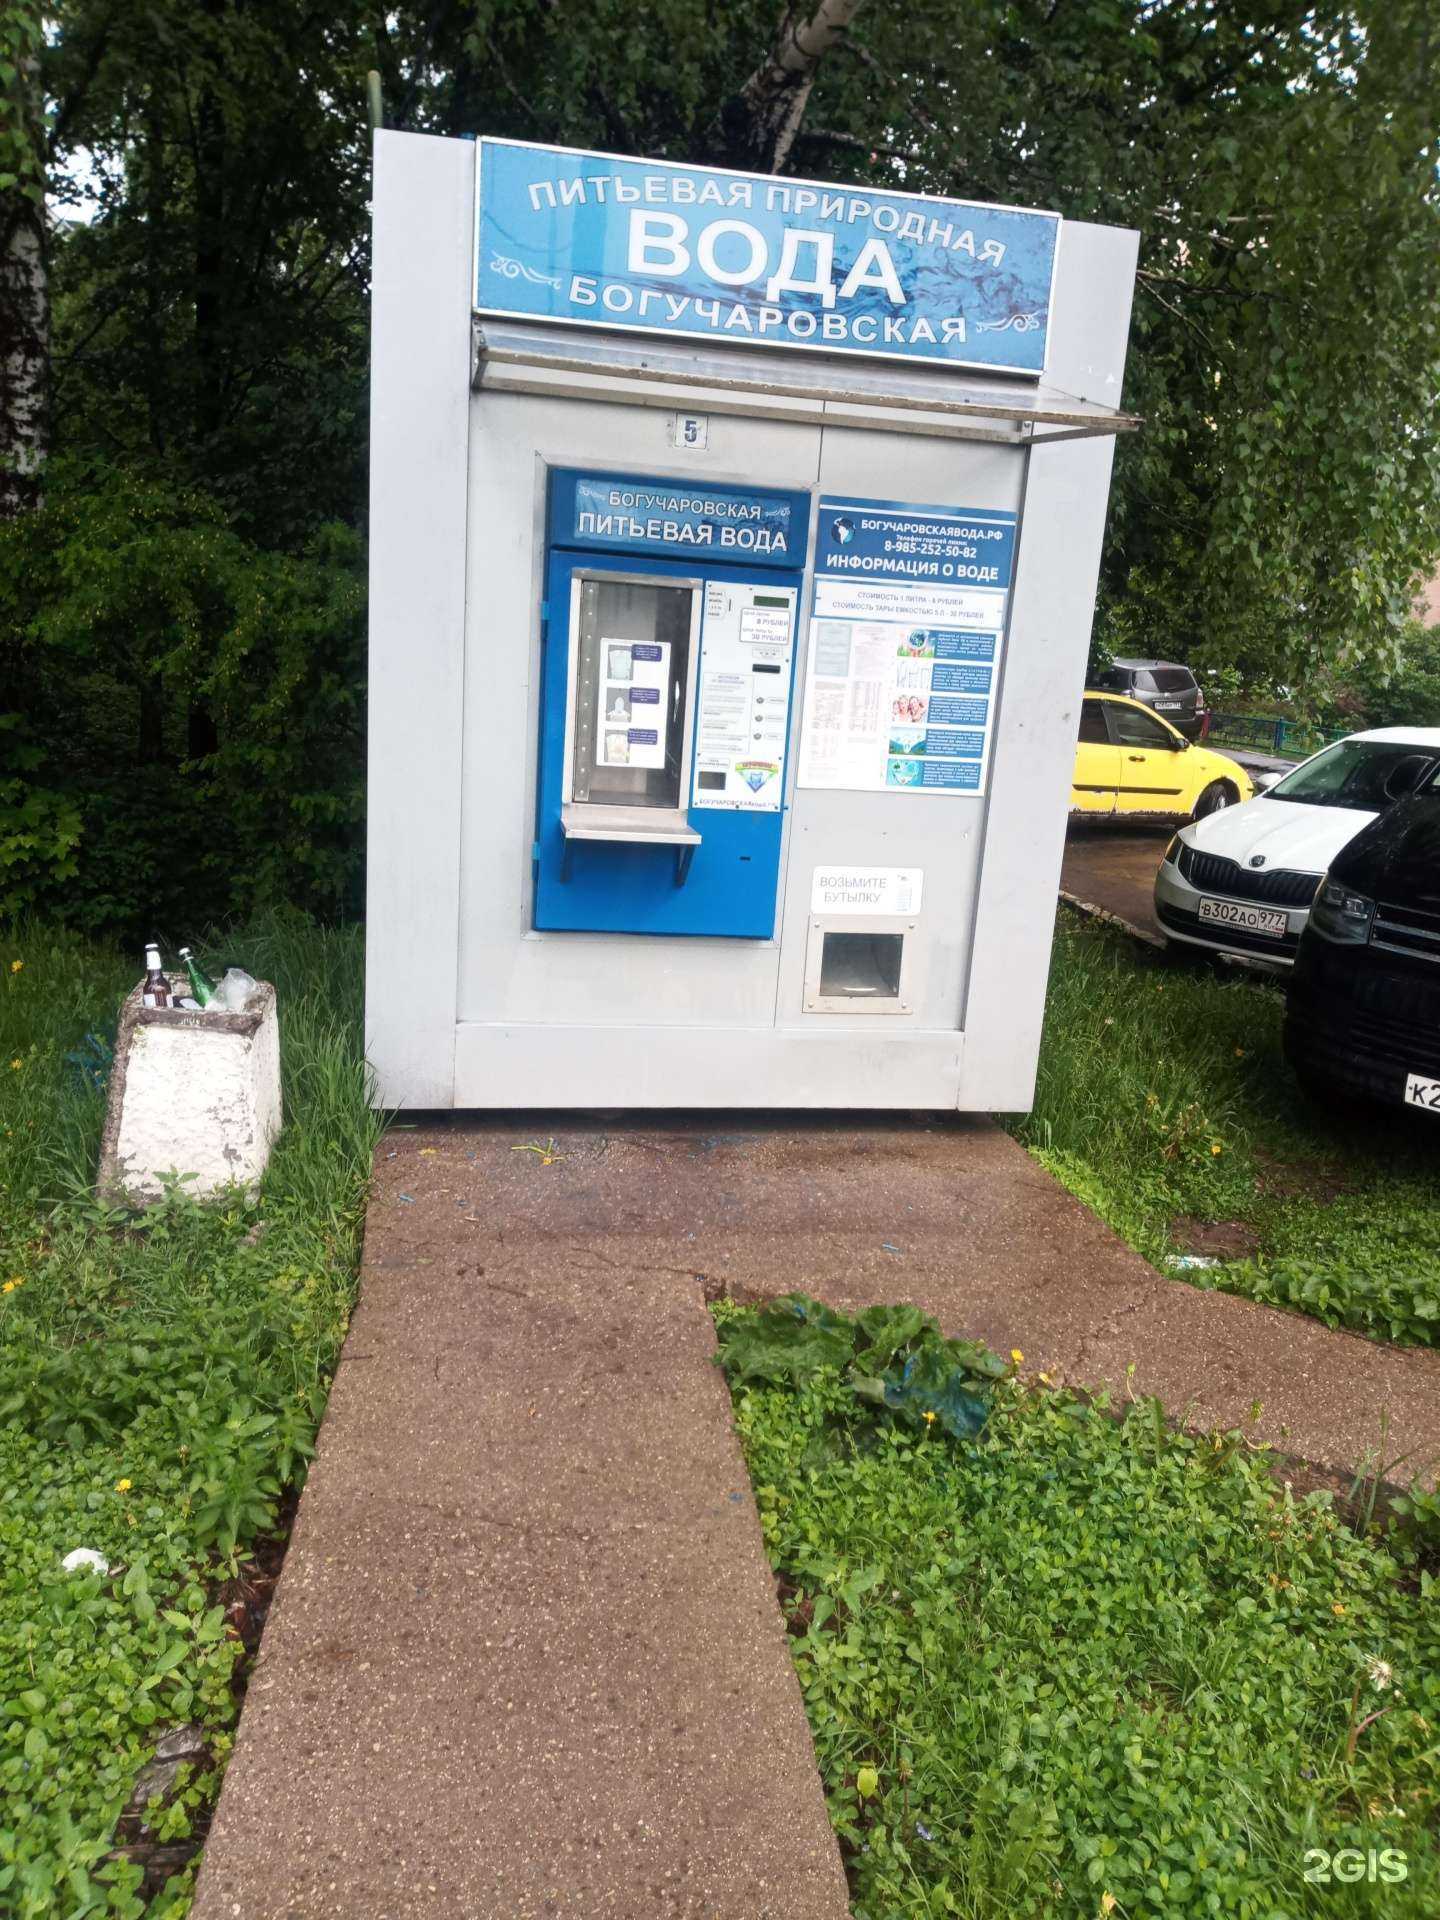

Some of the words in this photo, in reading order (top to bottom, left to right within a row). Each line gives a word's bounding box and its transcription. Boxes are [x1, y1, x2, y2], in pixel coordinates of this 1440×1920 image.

[528, 174, 754, 212] ПИТЬЕВАЯ
[765, 186, 1007, 268] ПРИРОДНАЯ
[627, 208, 906, 309] ВОДА
[569, 275, 968, 345] БОГУЧАРОВСКАЯ
[682, 419, 698, 444] 5
[609, 490, 762, 520] БОГУЧАРОВСКАЯ
[578, 512, 713, 545] ПИТЬЕВАЯ
[720, 527, 788, 553] ВОДА
[861, 519, 1004, 541] БОГУЧАРОВСКАЯВОДА.РФ
[885, 541, 977, 558] 8-985-252-50-82
[826, 553, 939, 577] ИНФОРМАЦИЯ
[942, 563, 954, 576] О
[957, 564, 999, 582] ВОДЕ
[832, 601, 874, 611] СТОИМОСТЬ
[857, 591, 899, 602] СТОИМОСТЬ
[819, 876, 887, 889] ВОЗЬМИТЕ
[824, 891, 881, 904] БУТЫЛКУ
[1260, 911, 1283, 926] 977
